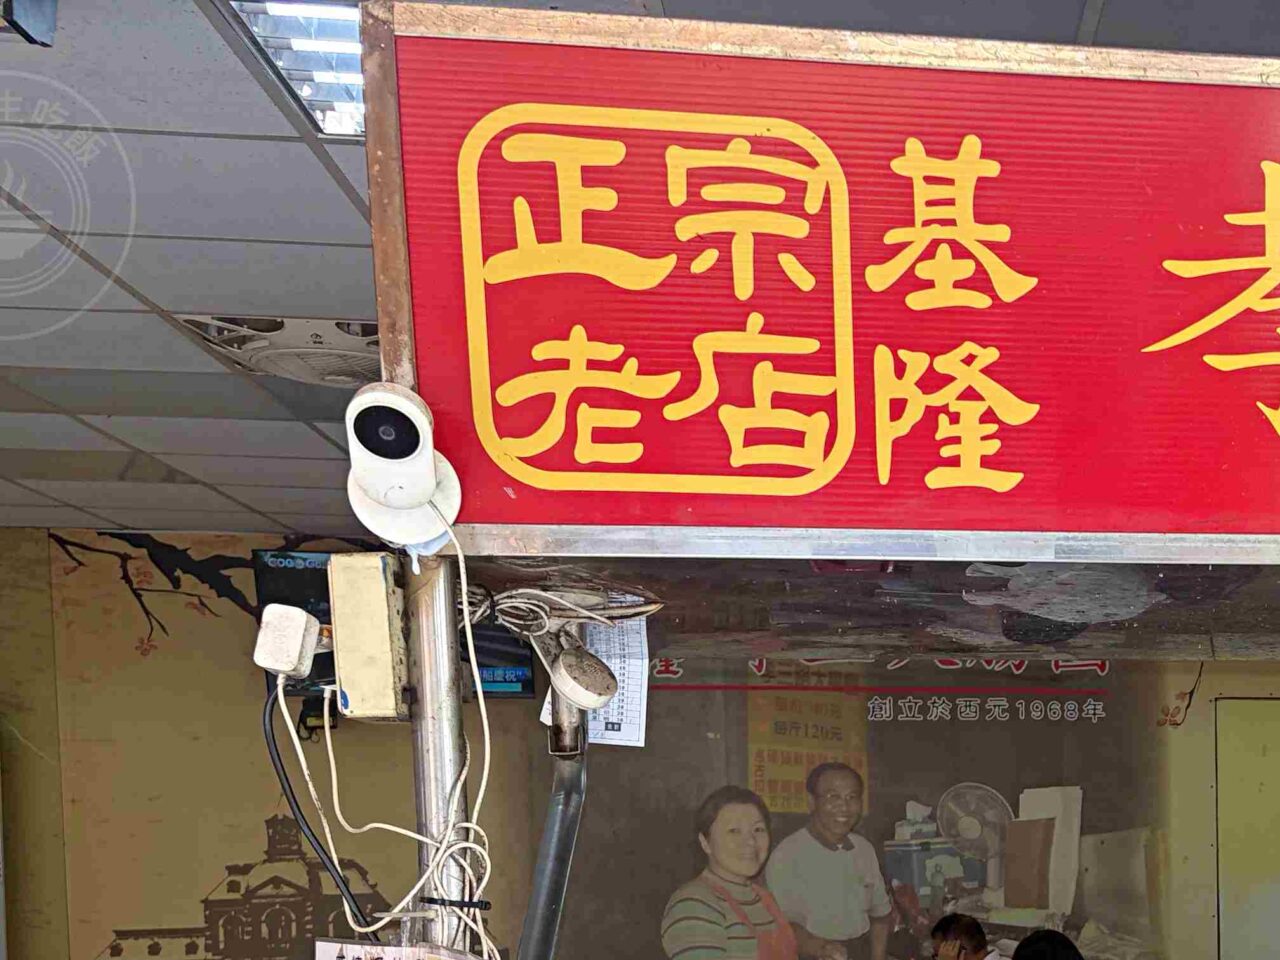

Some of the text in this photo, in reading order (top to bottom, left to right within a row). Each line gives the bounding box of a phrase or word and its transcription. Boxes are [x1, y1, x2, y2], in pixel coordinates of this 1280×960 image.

[484, 133, 831, 300] 正宗
[496, 312, 838, 468] 老店
[864, 134, 1040, 492] 基隆
[867, 696, 1106, 723] 創立於西元1968年
